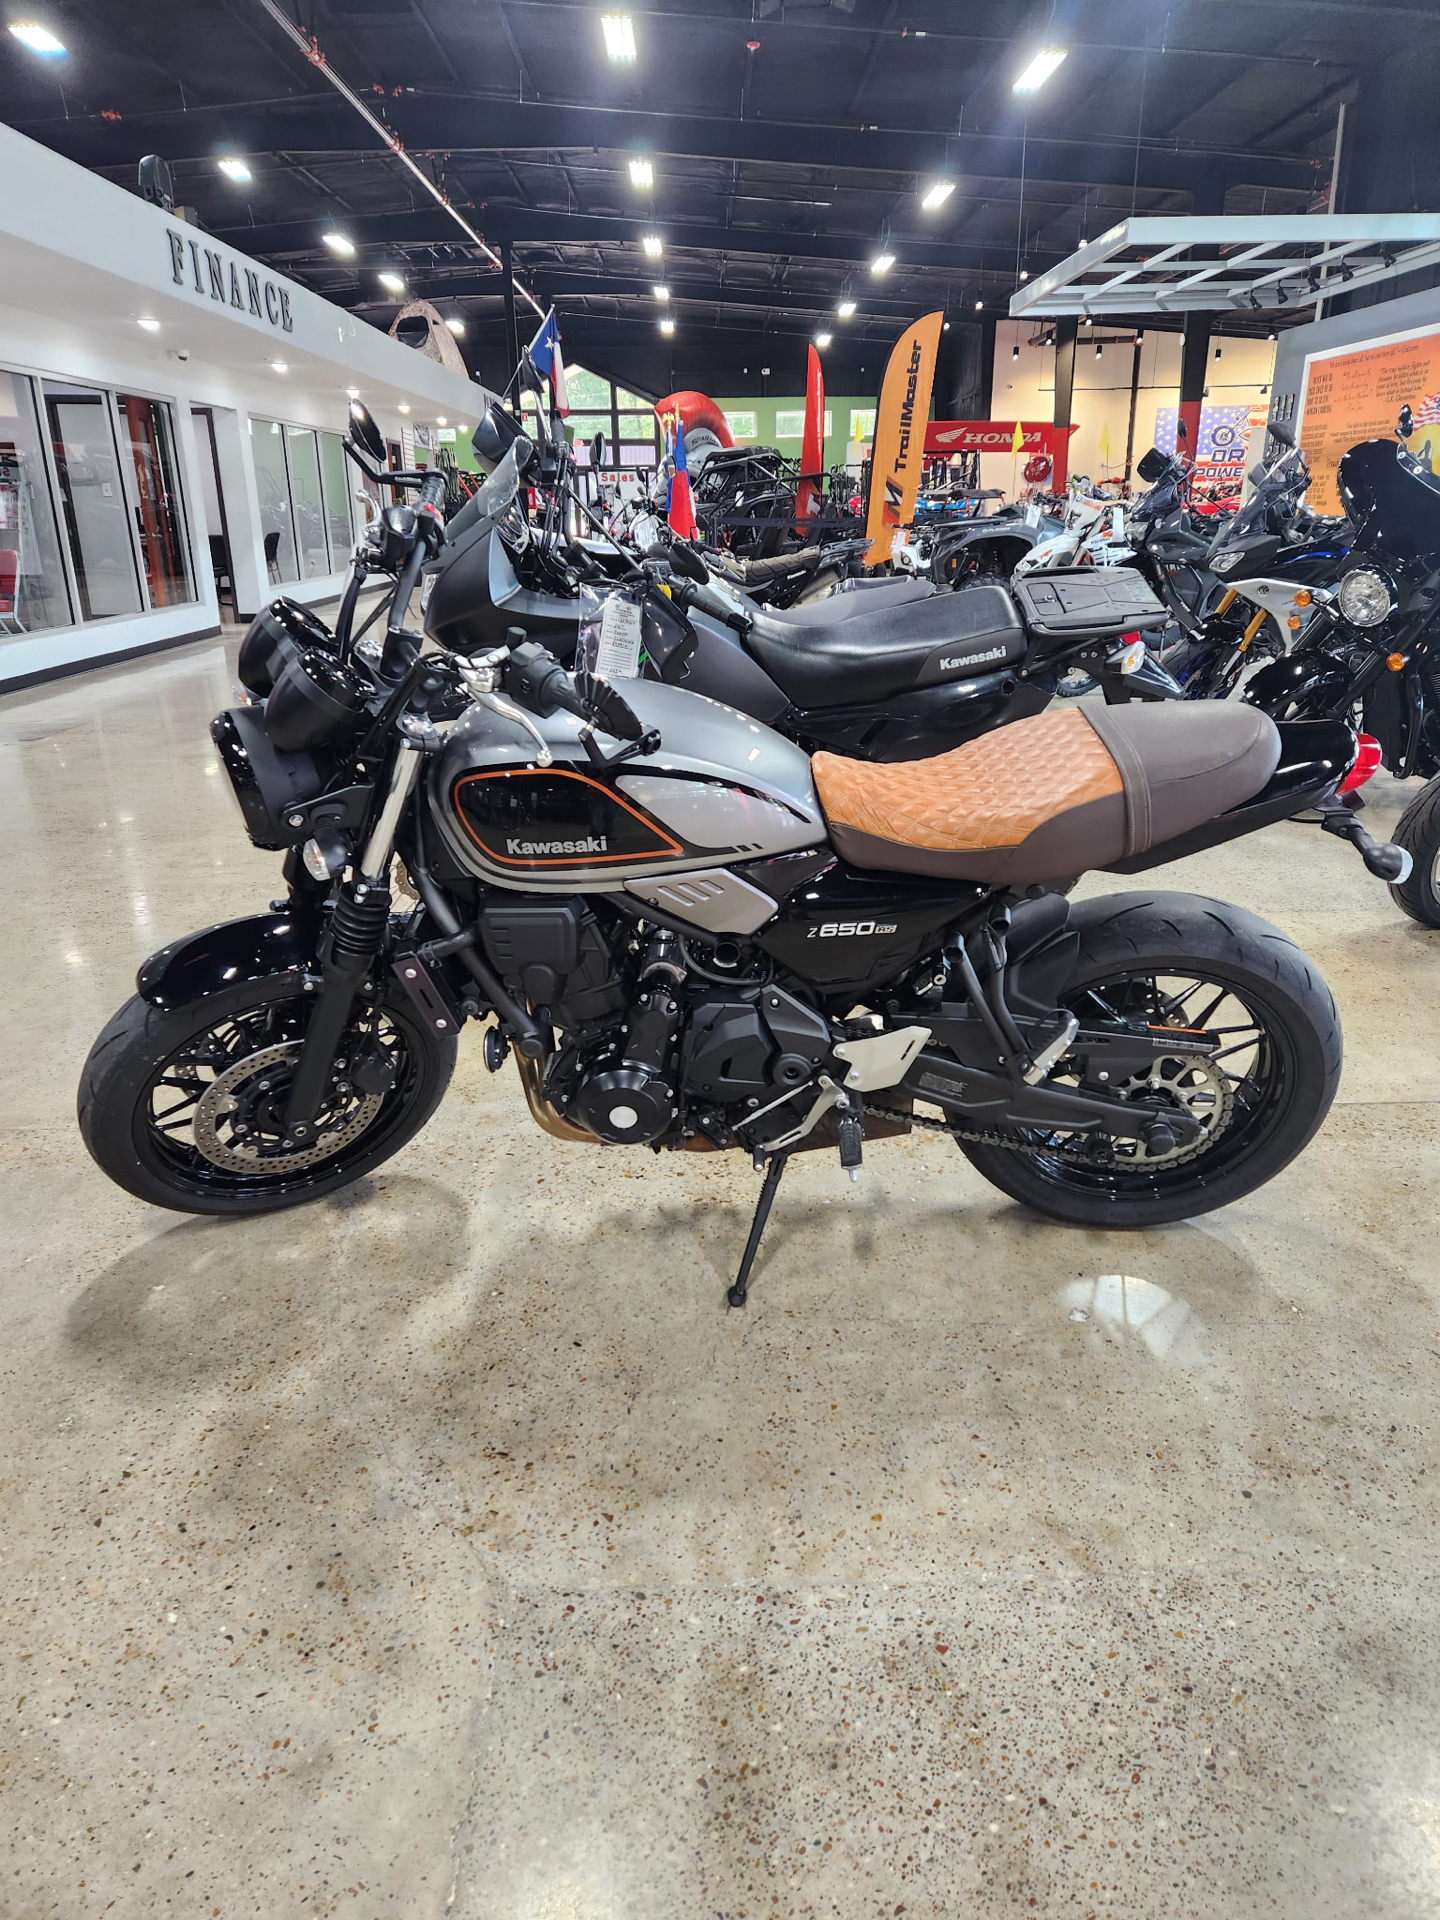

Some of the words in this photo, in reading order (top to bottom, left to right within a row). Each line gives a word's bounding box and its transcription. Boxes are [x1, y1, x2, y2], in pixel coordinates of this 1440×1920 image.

[166, 228, 293, 332] FINANCE
[894, 339, 922, 473] TrailMaster
[601, 472, 635, 482] Sales
[940, 645, 1007, 671] Kawasaki
[506, 835, 607, 855] Kawasaki
